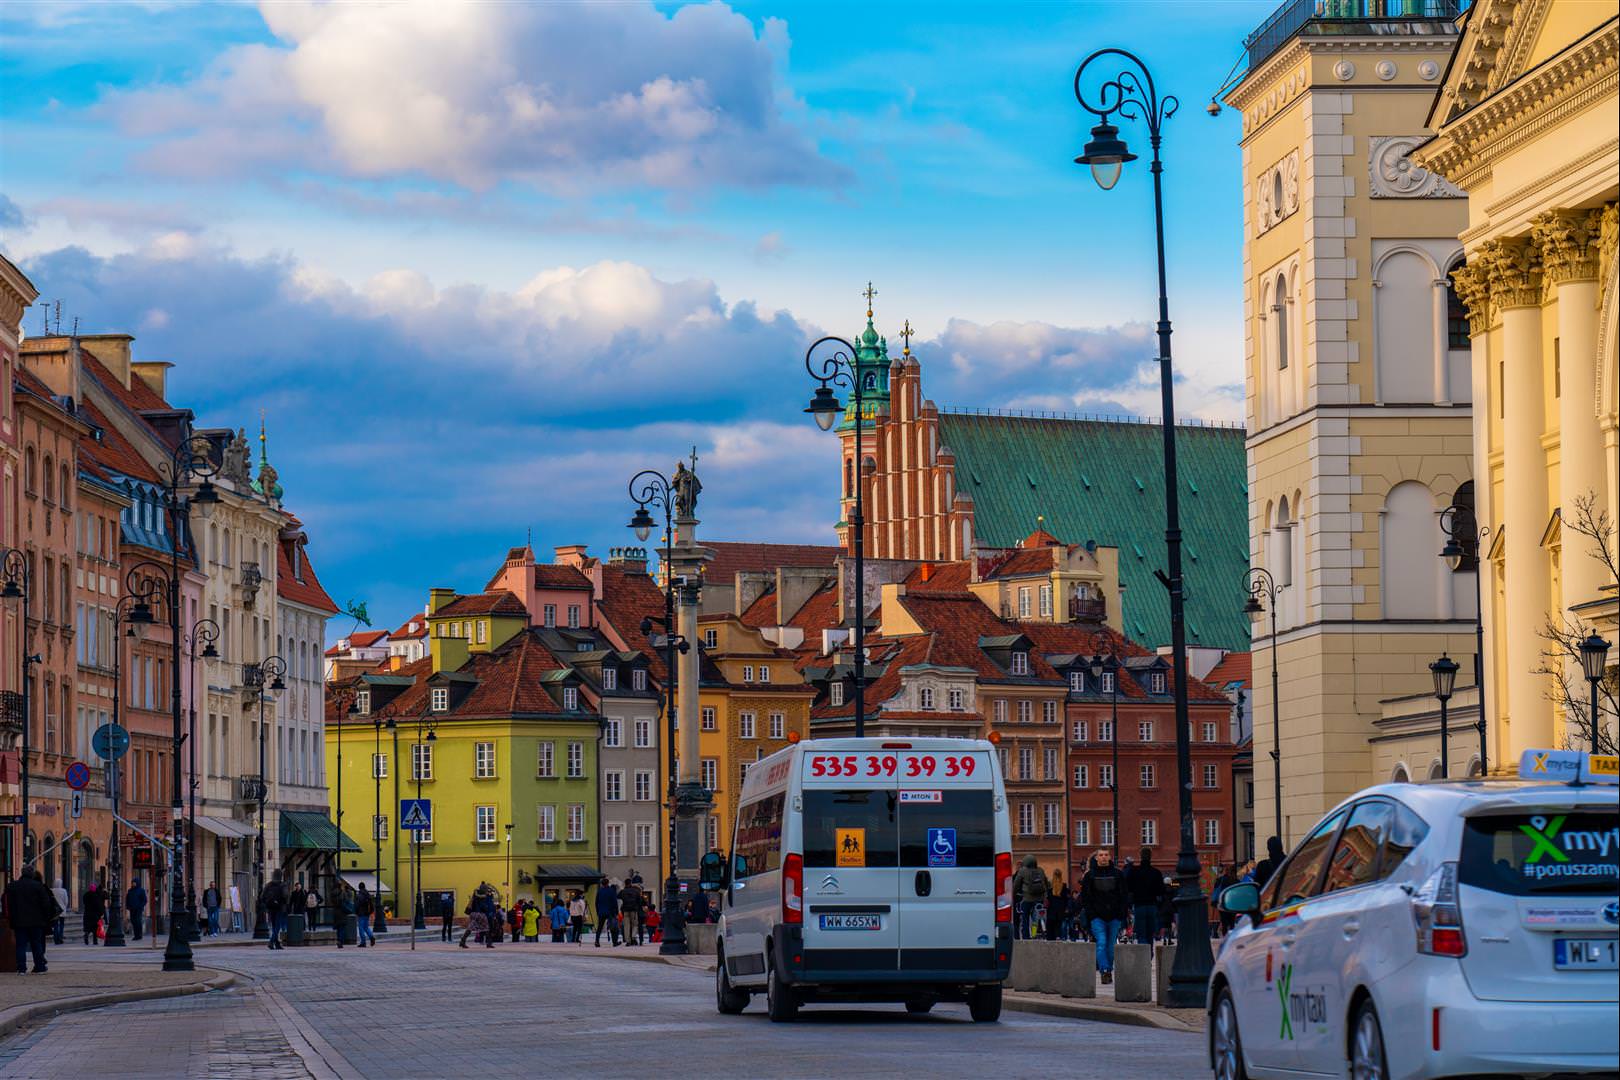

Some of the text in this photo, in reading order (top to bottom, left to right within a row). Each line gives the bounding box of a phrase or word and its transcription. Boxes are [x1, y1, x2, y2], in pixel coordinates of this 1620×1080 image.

[811, 756, 858, 777] 535
[865, 756, 897, 777] 39
[905, 756, 937, 777] 39
[944, 756, 976, 777] 39
[826, 916, 879, 928] WW 665XW
[1569, 941, 1599, 963] WL
